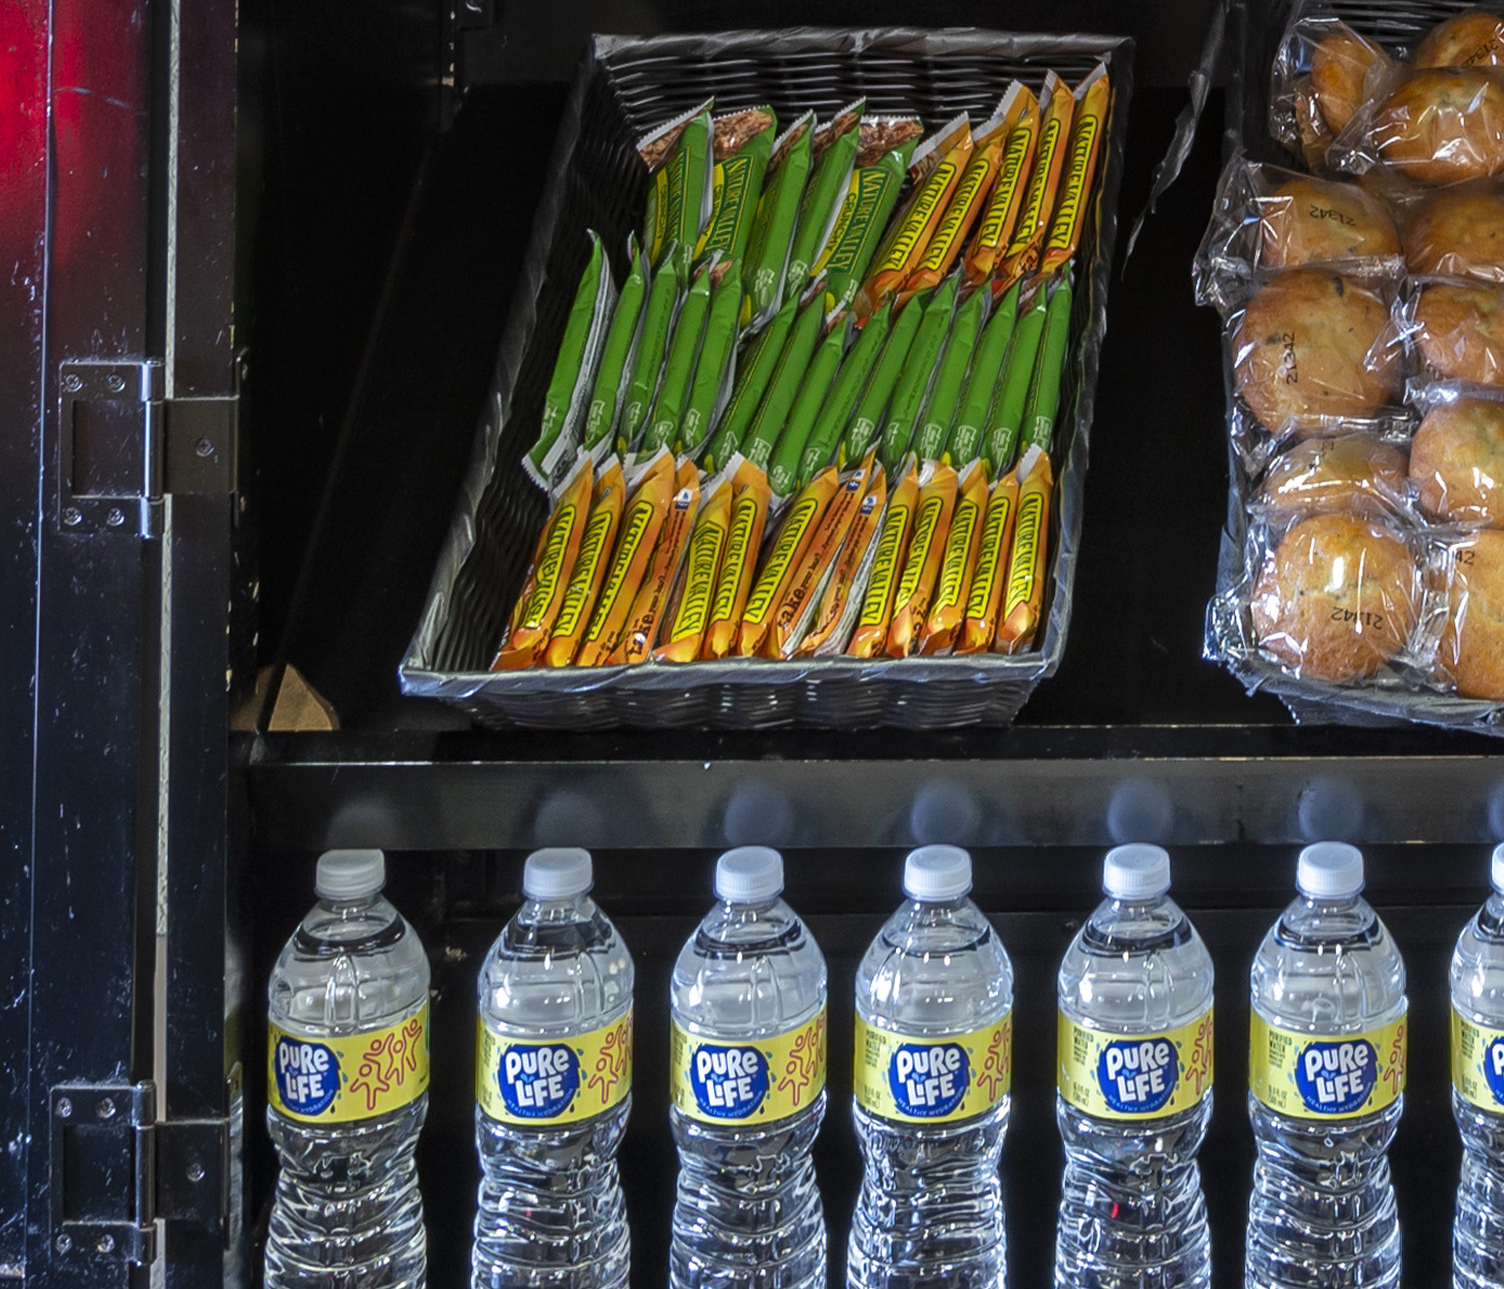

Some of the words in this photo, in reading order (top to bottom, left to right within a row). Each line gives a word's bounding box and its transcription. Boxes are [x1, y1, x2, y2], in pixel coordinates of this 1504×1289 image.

[826, 193, 857, 251] CRUNCHY
[855, 172, 886, 222] NATURE
[827, 222, 866, 270] VALLEY
